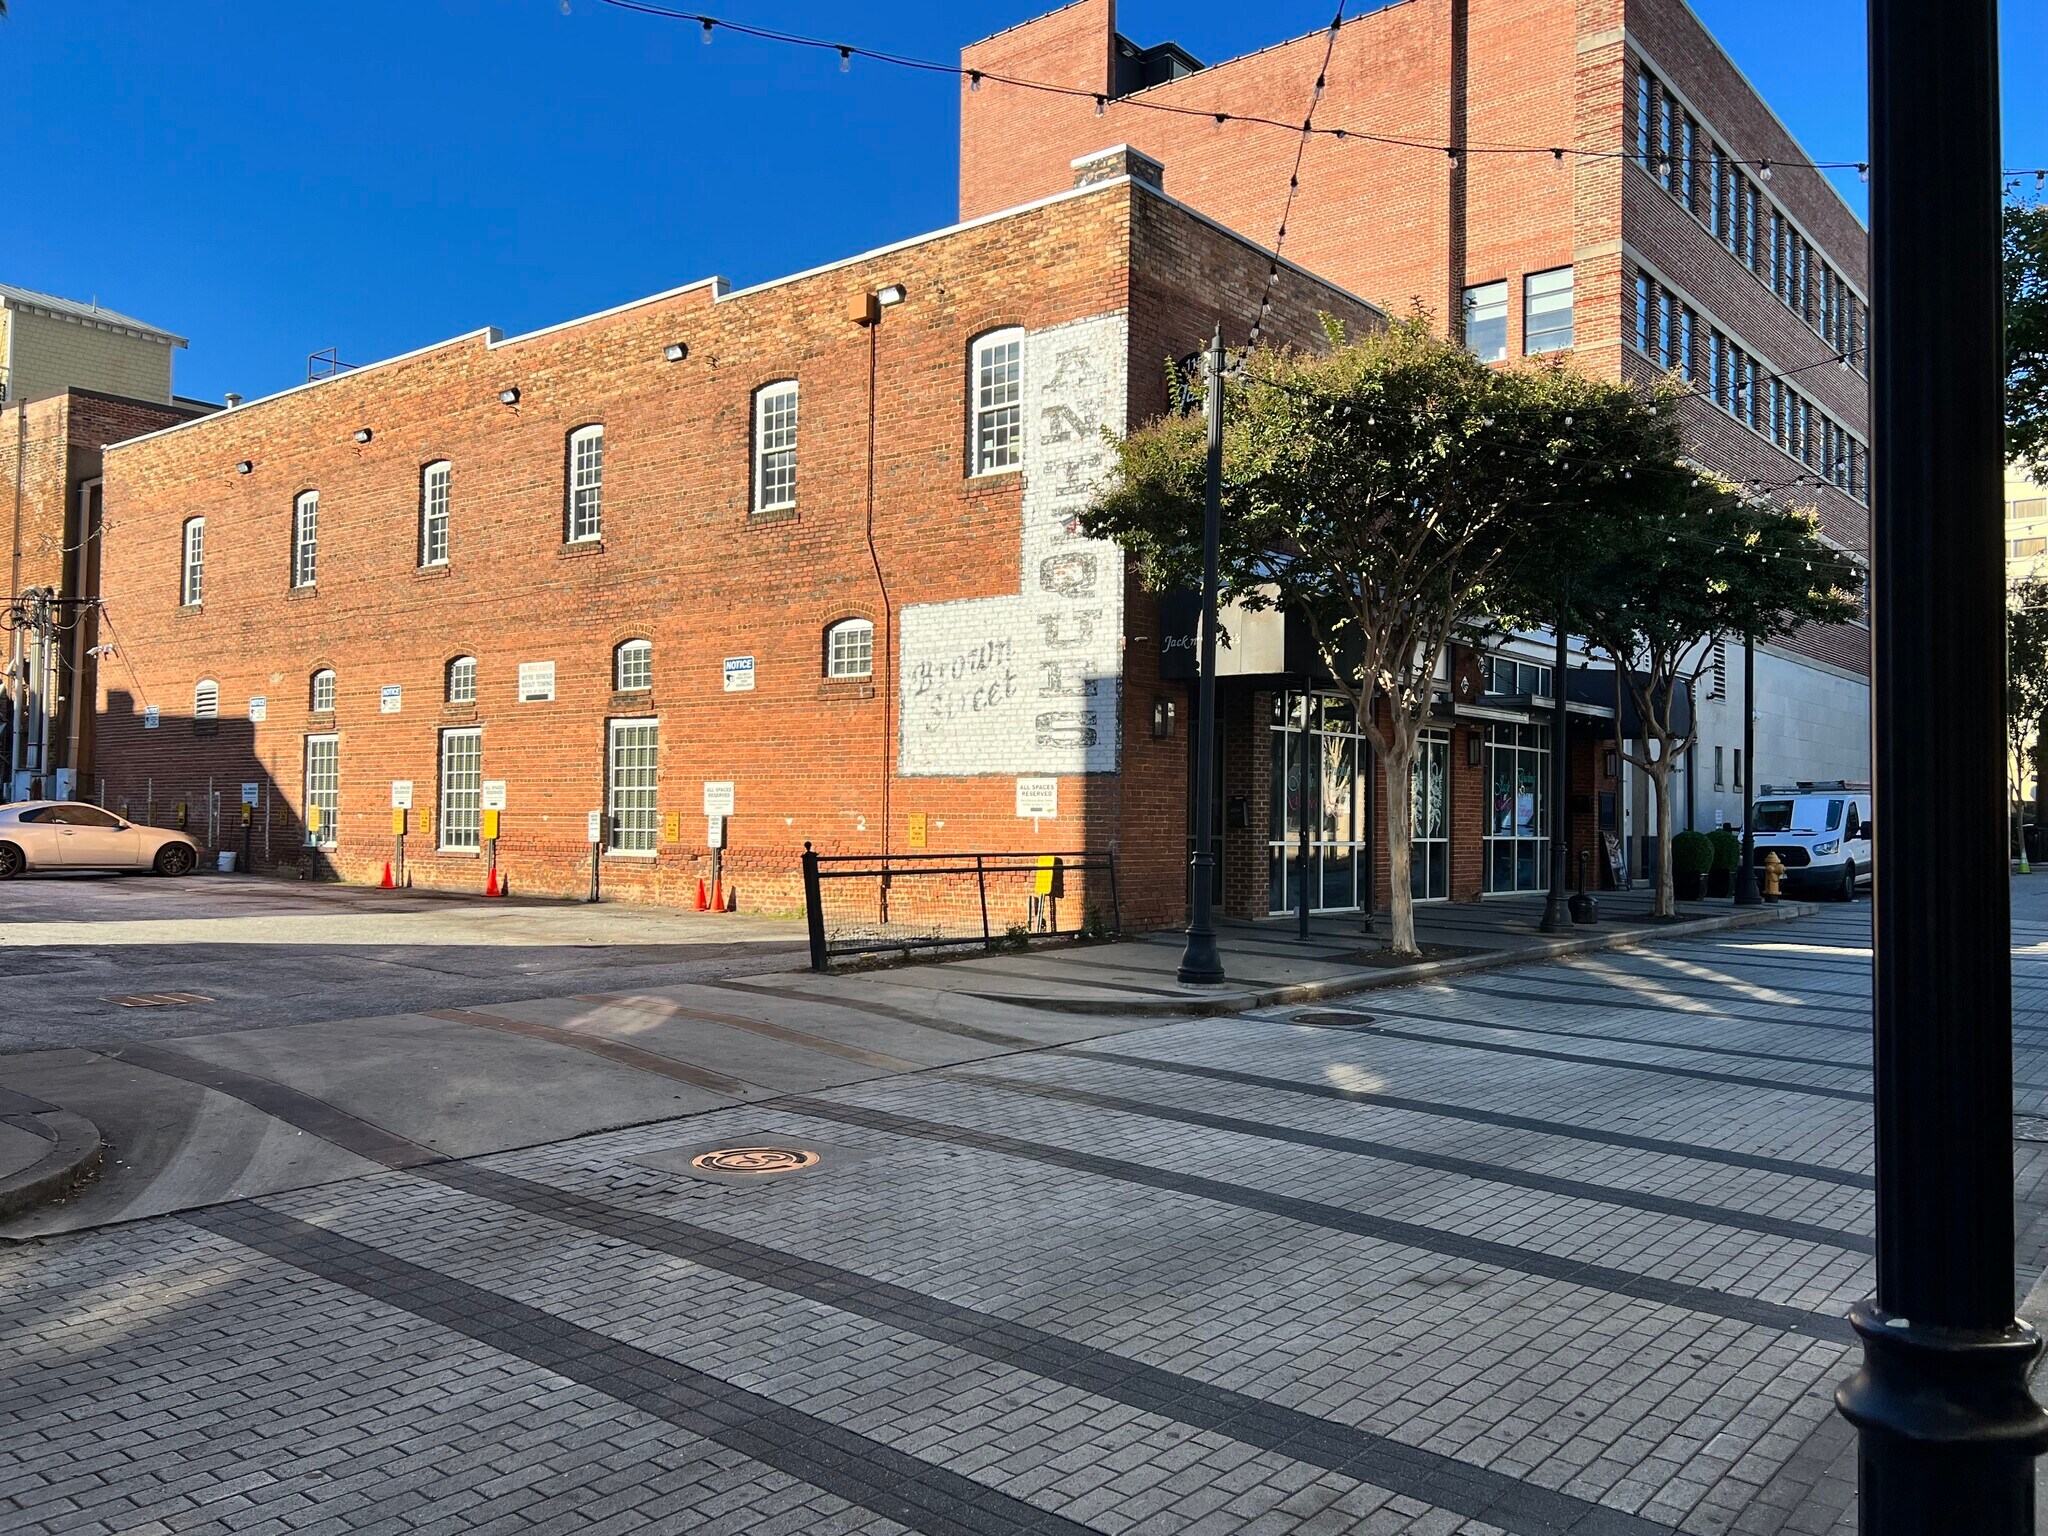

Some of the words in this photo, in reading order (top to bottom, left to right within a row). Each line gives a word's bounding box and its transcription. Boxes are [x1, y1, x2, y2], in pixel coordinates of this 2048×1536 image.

[1161, 634, 1191, 653] Jack
[725, 659, 752, 670] NOTICE
[909, 636, 1016, 696] Brown
[925, 668, 1018, 734] Street
